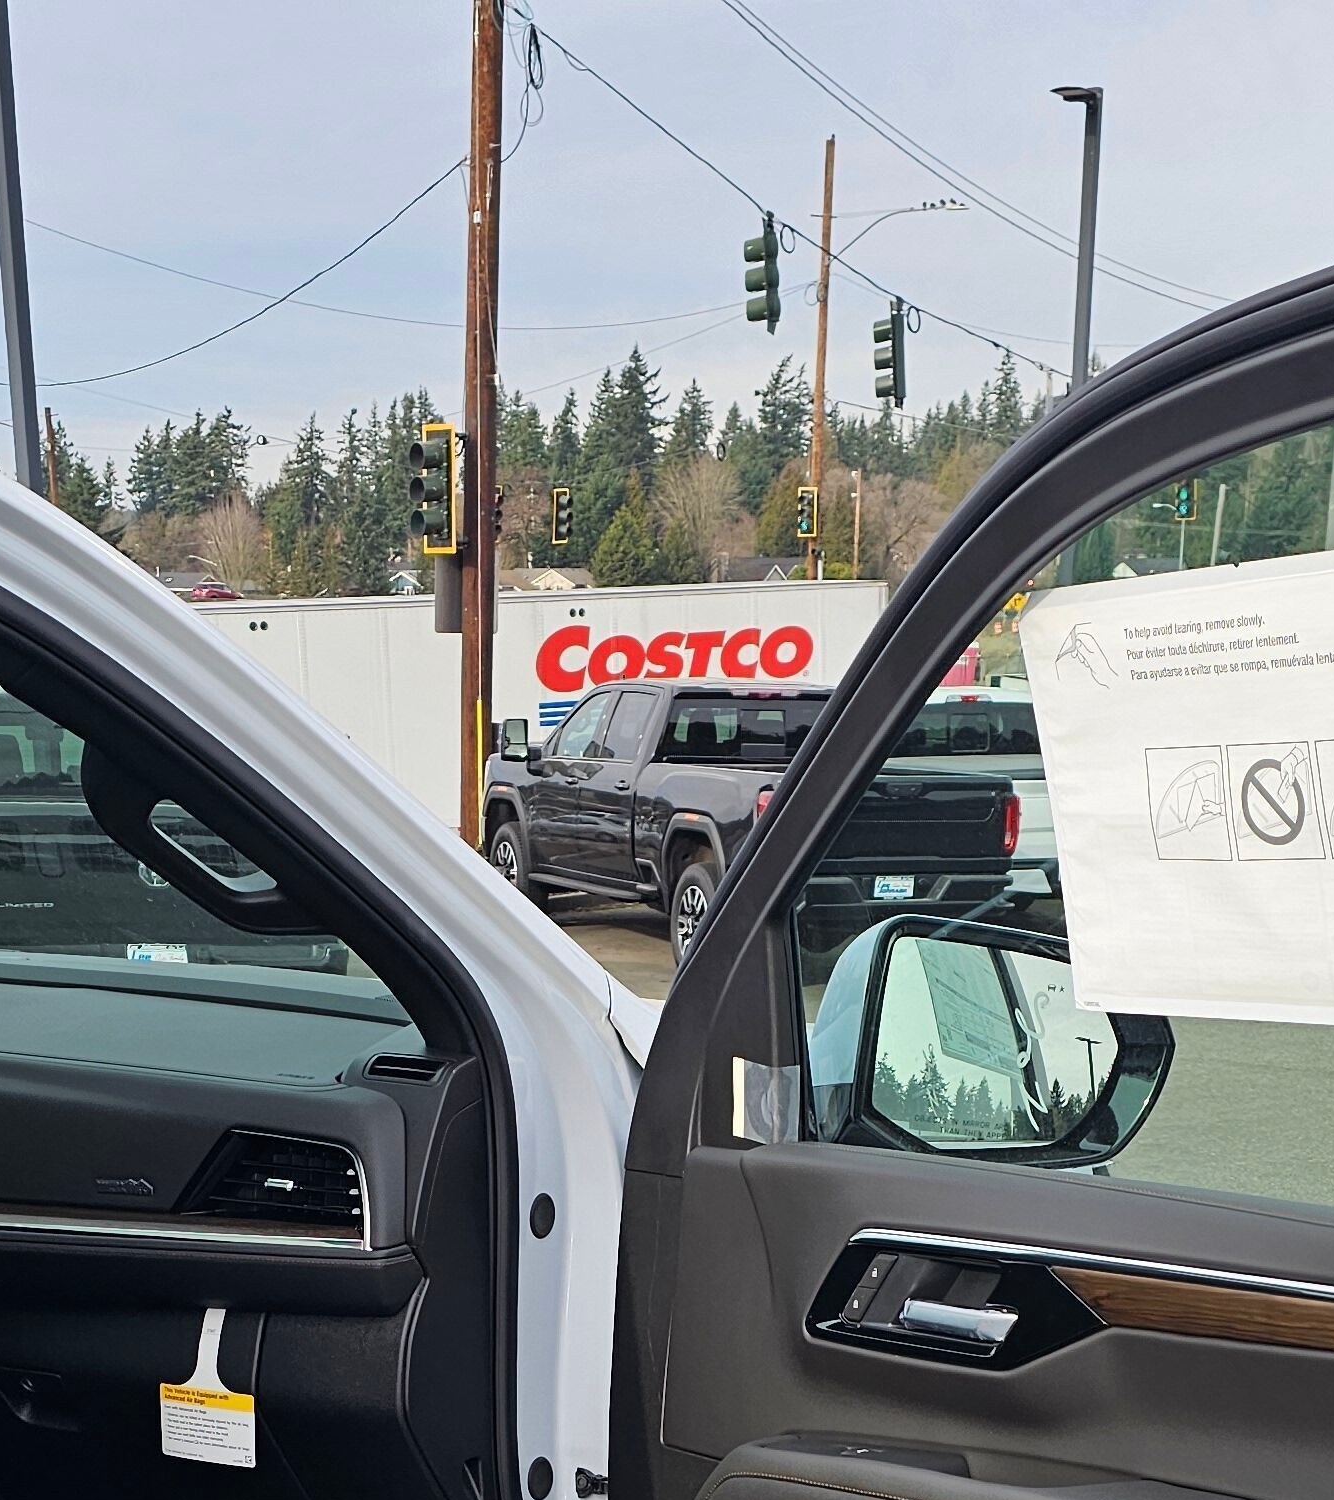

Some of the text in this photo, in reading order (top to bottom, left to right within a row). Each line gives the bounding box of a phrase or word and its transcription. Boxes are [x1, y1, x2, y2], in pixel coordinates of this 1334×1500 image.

[1124, 613, 1266, 640] To help avoid tearing, remove slowly.
[1126, 648, 1143, 661] Pour
[1168, 644, 1187, 657] toute
[1188, 640, 1228, 655] déchirure,
[1229, 637, 1254, 650] retirer
[536, 625, 814, 692] COSTCO
[1130, 669, 1148, 681] Para
[1149, 666, 1183, 682] ayudarse
[1183, 667, 1190, 676] a
[1190, 663, 1212, 676] evitar
[1213, 663, 1228, 676] que
[1229, 662, 1239, 672] se
[1240, 659, 1269, 673] rompa,
[1270, 653, 1315, 669] remuévala
[939, 1126, 960, 1136] THAN
[963, 1128, 983, 1138] THEY
[962, 1118, 990, 1129] MIRROR
[164, 1393, 186, 1402] Advanced
[194, 1397, 206, 1405] Bags
[174, 1387, 191, 1396] Vehicle
[196, 1390, 218, 1399] Equipped
